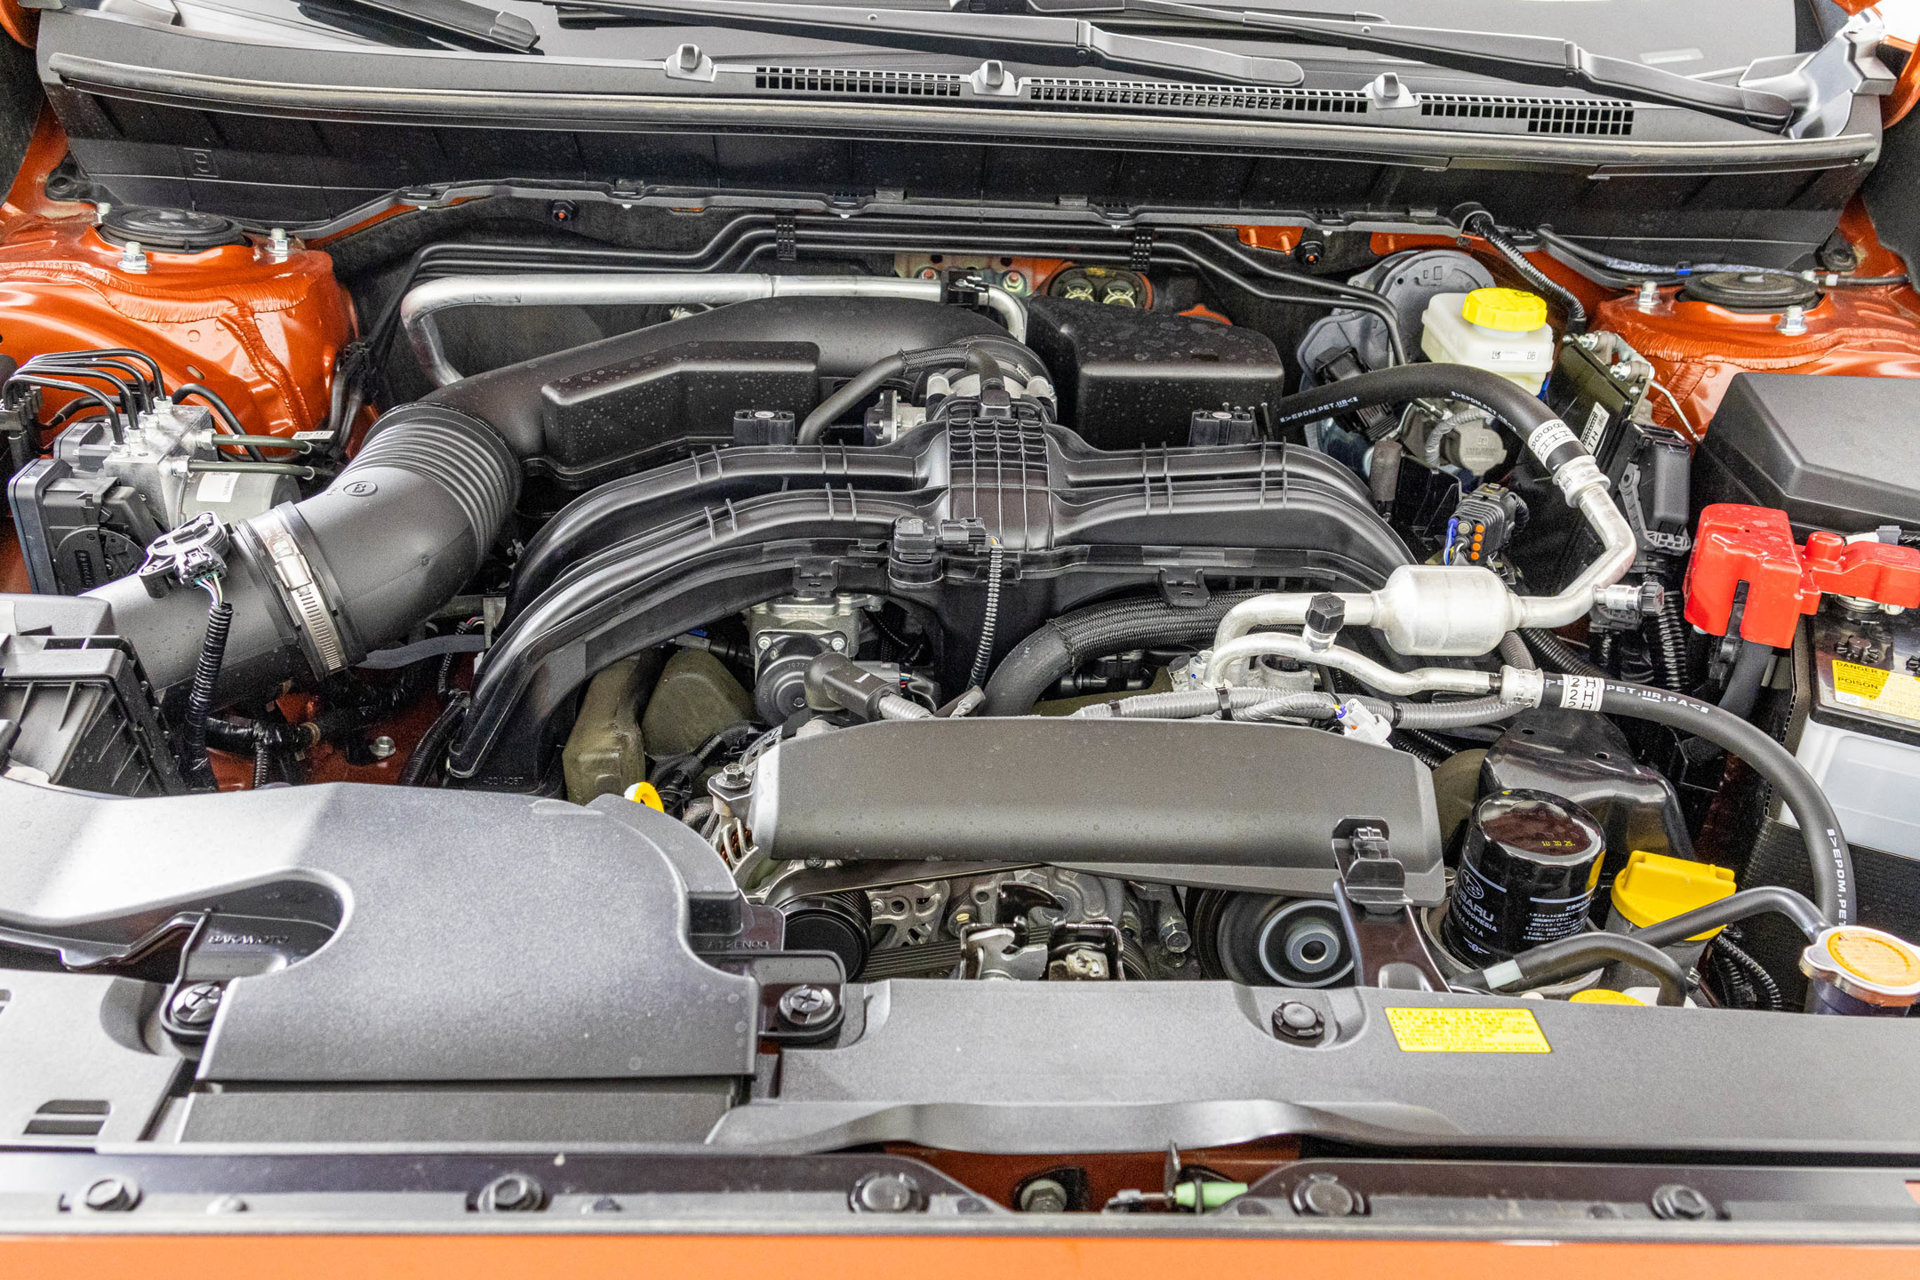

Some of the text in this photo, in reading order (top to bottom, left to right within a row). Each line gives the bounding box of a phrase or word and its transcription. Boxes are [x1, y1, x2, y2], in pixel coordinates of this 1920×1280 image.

[1838, 676, 1878, 690] POISON
[1455, 885, 1495, 922] BARU
[1461, 904, 1498, 933] INDONESIA
